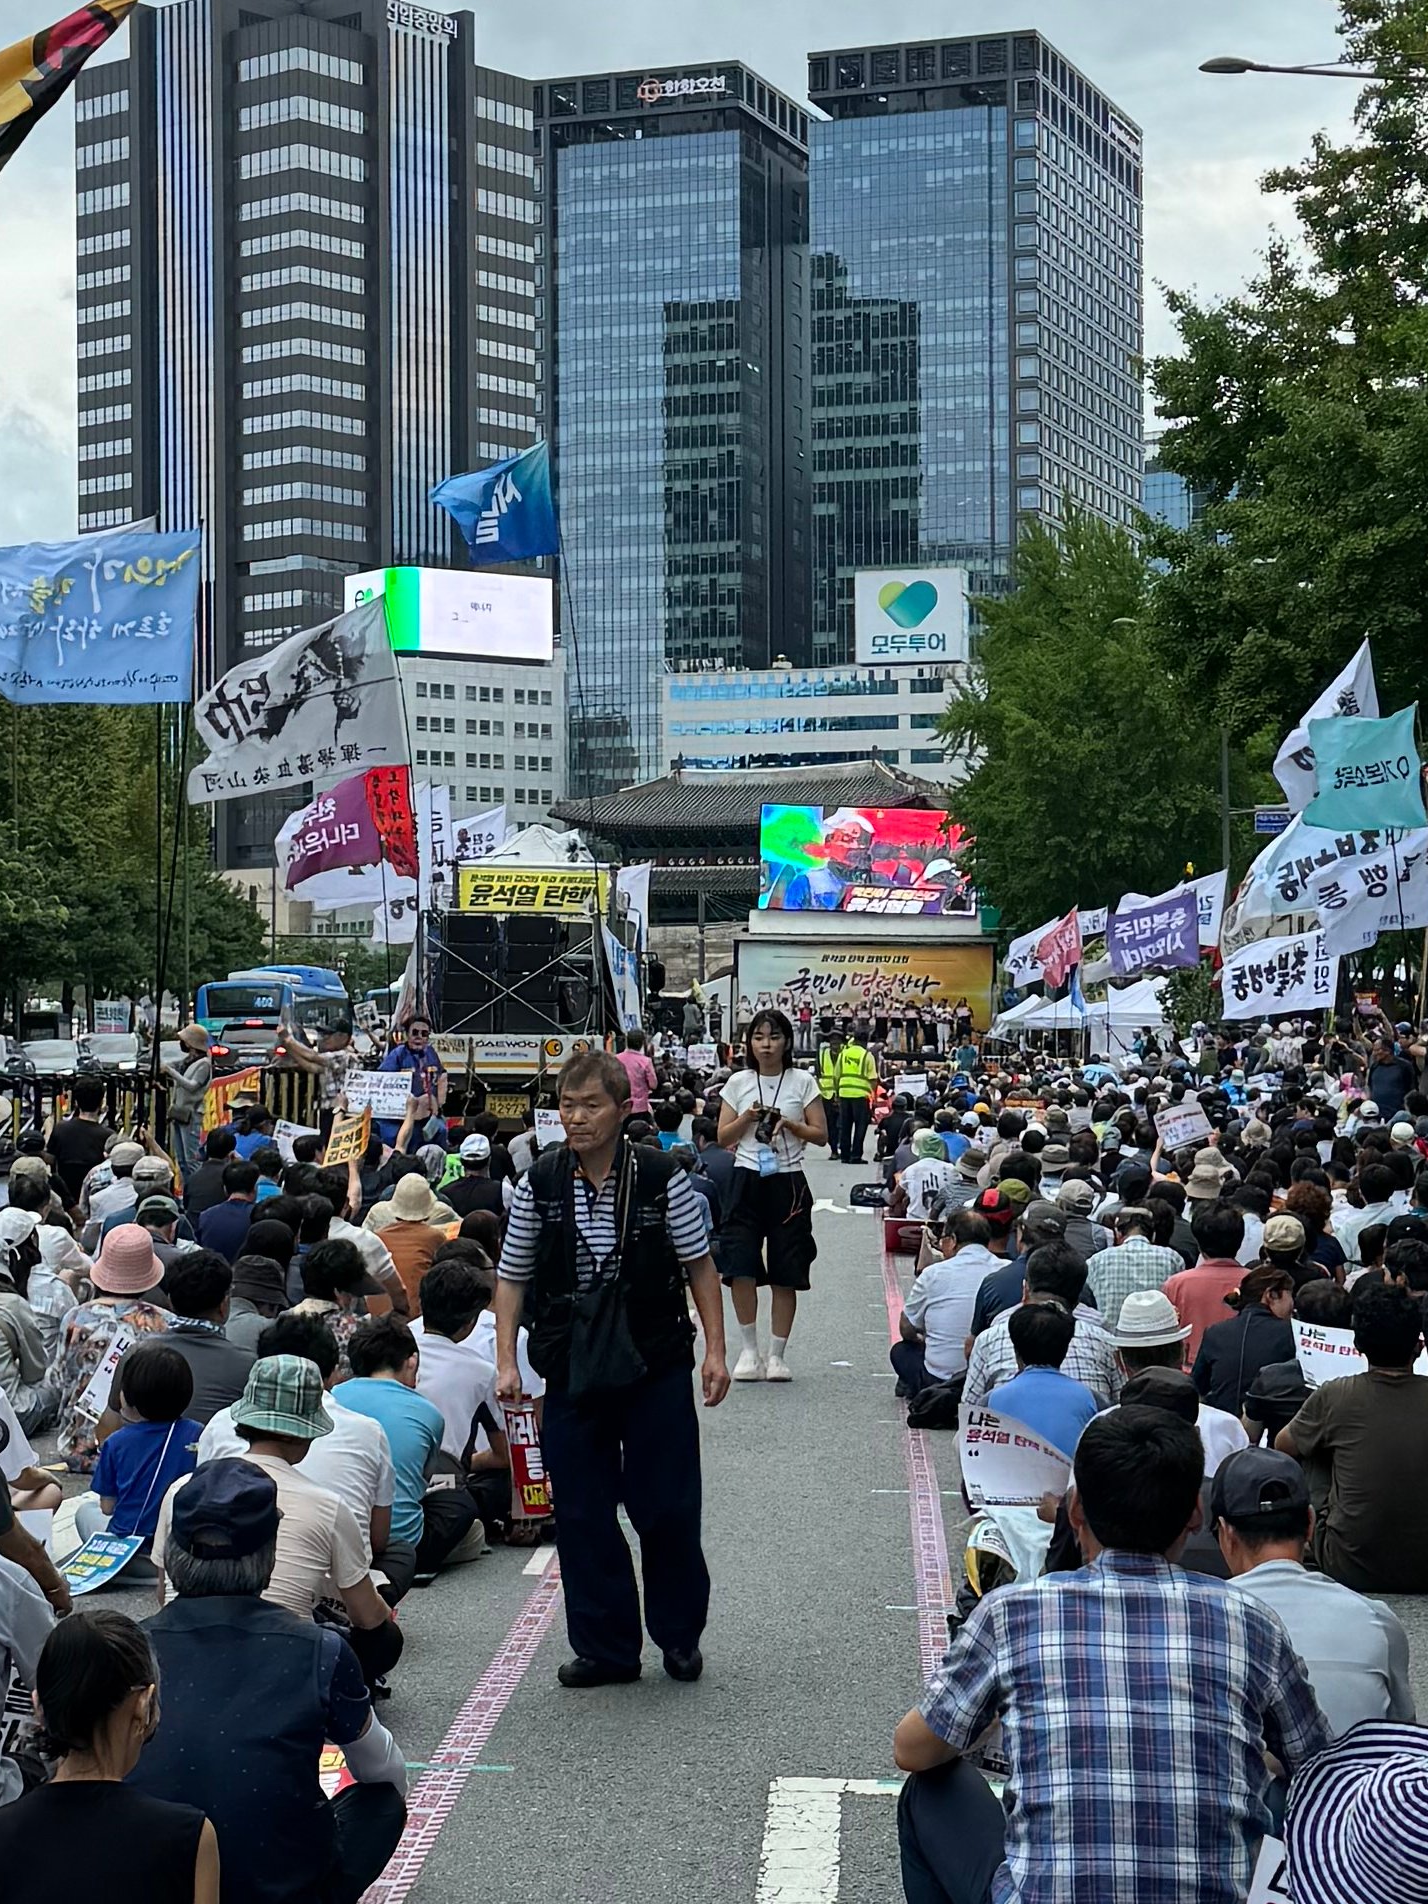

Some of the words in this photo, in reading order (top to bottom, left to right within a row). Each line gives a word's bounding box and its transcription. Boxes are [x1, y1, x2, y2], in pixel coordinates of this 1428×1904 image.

[871, 634, 946, 653] 모두투어
[469, 883, 540, 907] 윤석열
[785, 967, 847, 995] 국민이
[851, 967, 941, 996] 명령한다
[475, 1040, 539, 1049] DAEWOO
[1300, 1325, 1327, 1341] 나는
[968, 1410, 1000, 1427] 나는
[966, 1428, 1010, 1445] 윤석열
